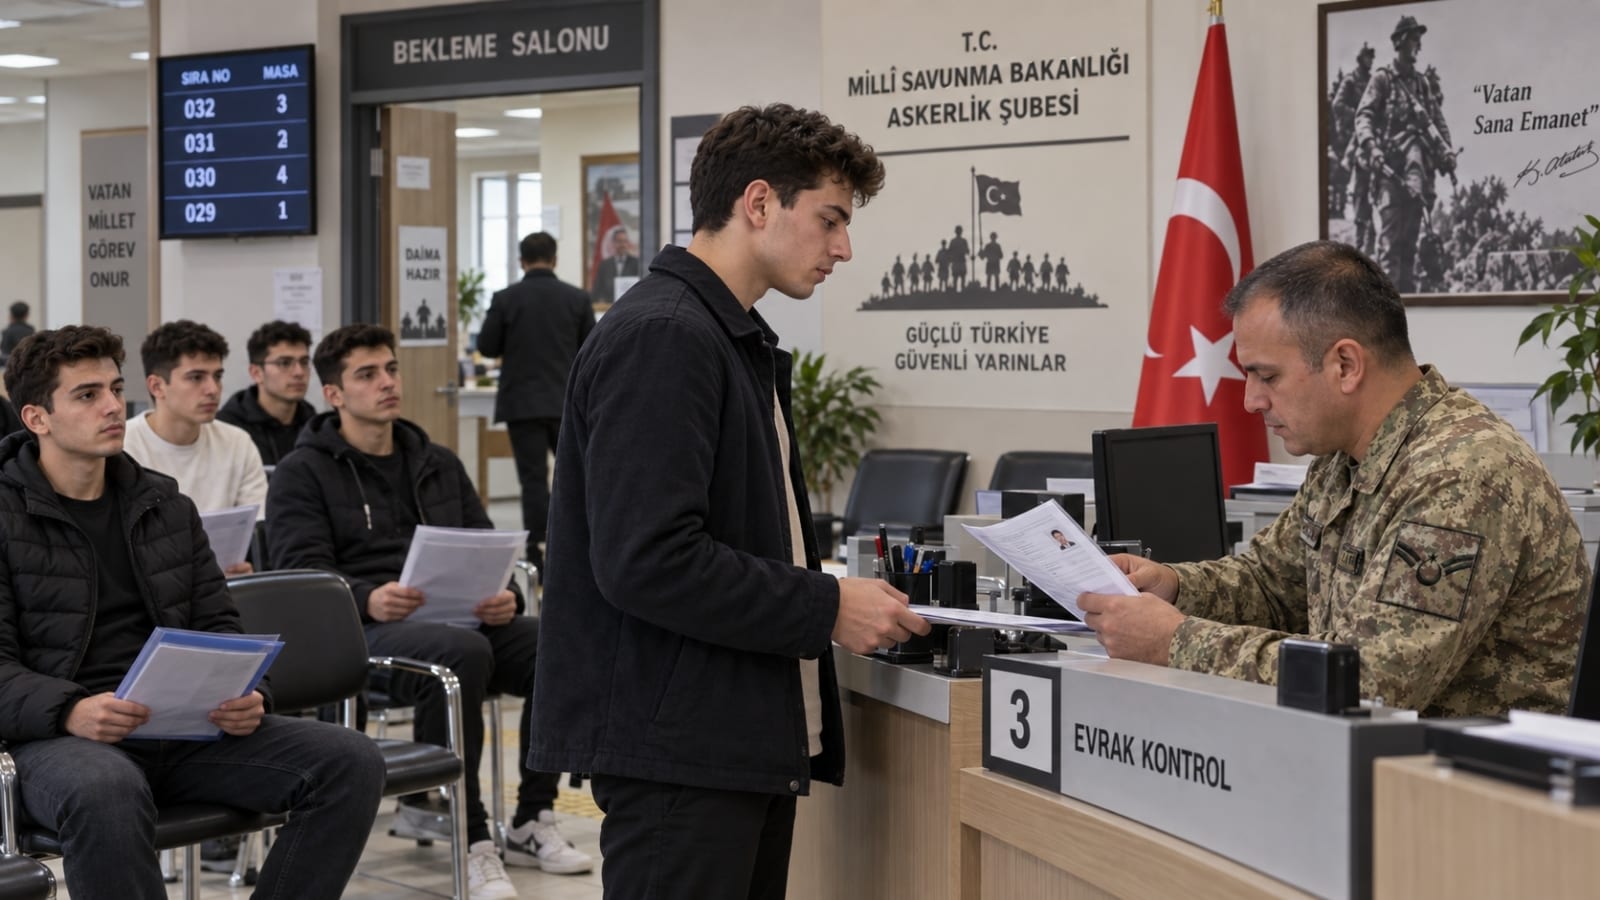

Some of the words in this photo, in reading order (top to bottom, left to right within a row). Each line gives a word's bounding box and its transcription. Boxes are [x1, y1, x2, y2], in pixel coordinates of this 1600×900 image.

[393, 33, 498, 64] BEKLEME
[512, 25, 610, 56] SALONU
[961, 31, 998, 53] T.C.
[181, 70, 210, 86] SIRA
[211, 68, 231, 83] NO
[263, 64, 299, 80] MASA
[848, 66, 897, 97] MİLLÎ
[901, 64, 1003, 92] SAVUNMA
[1010, 48, 1130, 83] BAKANLIĞI
[1473, 83, 1532, 105] “Vatan
[184, 98, 216, 120] 032
[276, 94, 288, 114] 3
[887, 95, 991, 129] ASKERLİK
[999, 88, 1079, 126] ŞUBESİ
[1473, 114, 1513, 135] Sana
[184, 132, 216, 154] 031
[277, 129, 288, 149] 2
[184, 167, 216, 188] 030
[276, 165, 288, 184] 4
[88, 182, 132, 201] VATAN
[88, 209, 136, 231] MİLLET
[185, 202, 217, 223] 029
[278, 201, 288, 219] 1
[88, 239, 136, 260] GÖREV
[405, 245, 441, 262] DAİMA
[90, 270, 130, 288] ONUR
[406, 267, 440, 281] HAZIR
[906, 322, 962, 348] GÜÇLÜ
[970, 321, 1049, 344] TÜRKİYE
[895, 349, 967, 370] GÜVENLİ
[975, 353, 1066, 372] YARINLAR
[1009, 688, 1031, 750] 3
[1074, 722, 1135, 766] EVRAK
[1142, 739, 1232, 792] KONTROL
